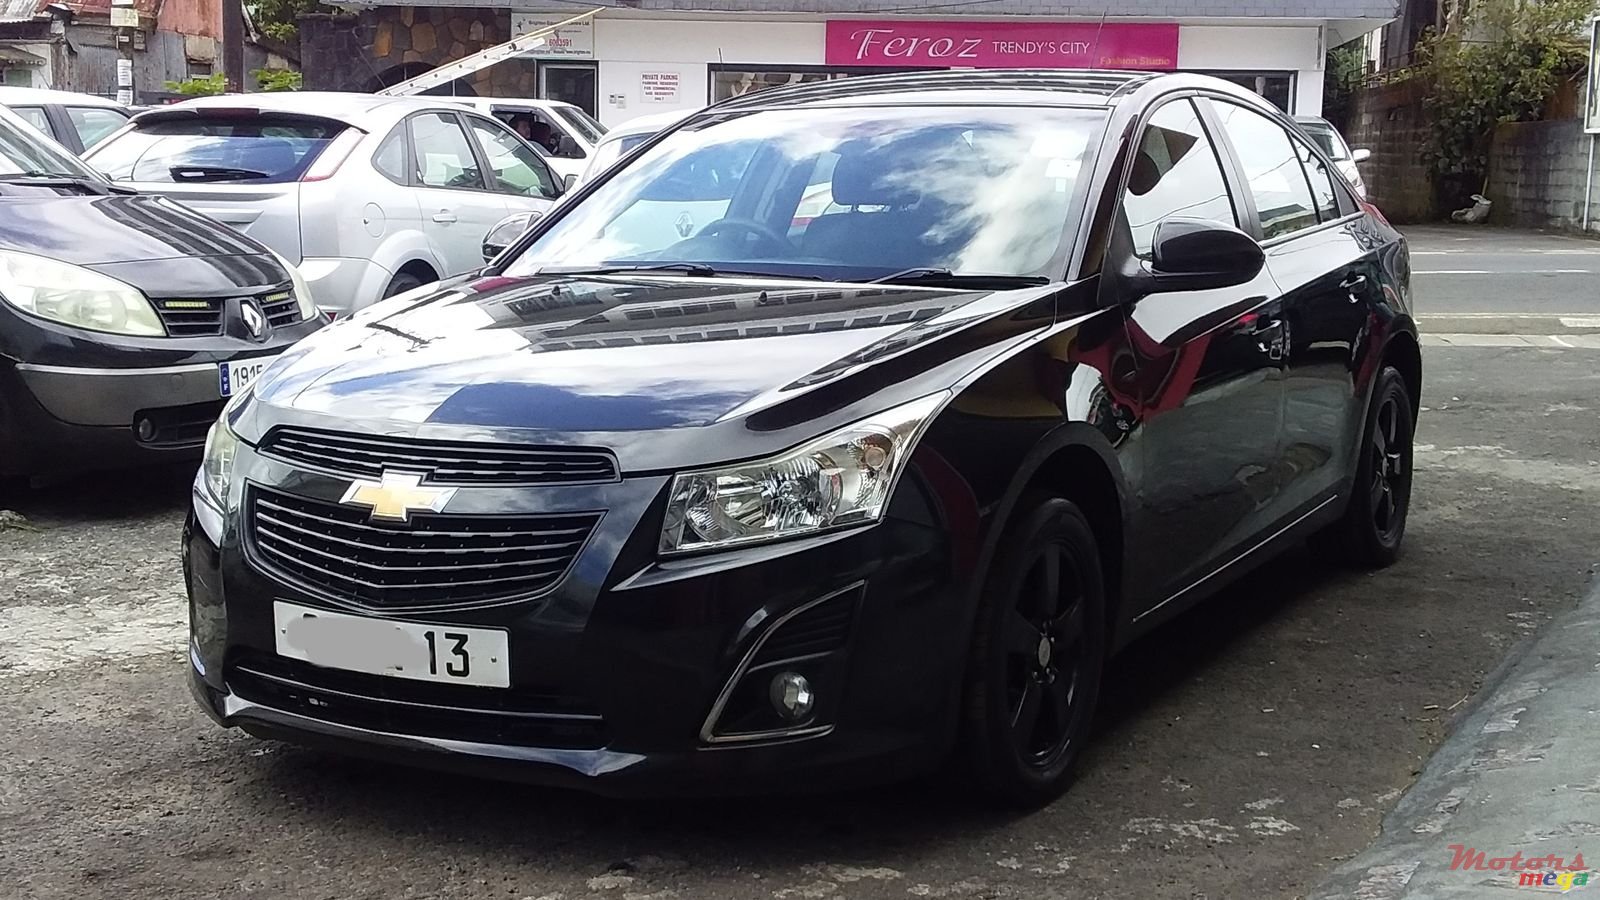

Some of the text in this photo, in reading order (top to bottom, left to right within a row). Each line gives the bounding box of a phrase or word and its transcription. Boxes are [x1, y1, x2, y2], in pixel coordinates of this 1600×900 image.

[850, 29, 982, 60] Feroz
[992, 41, 1090, 54] TRENDY'S CITY
[1100, 56, 1170, 65] Fashion Studio
[424, 630, 470, 677] 13
